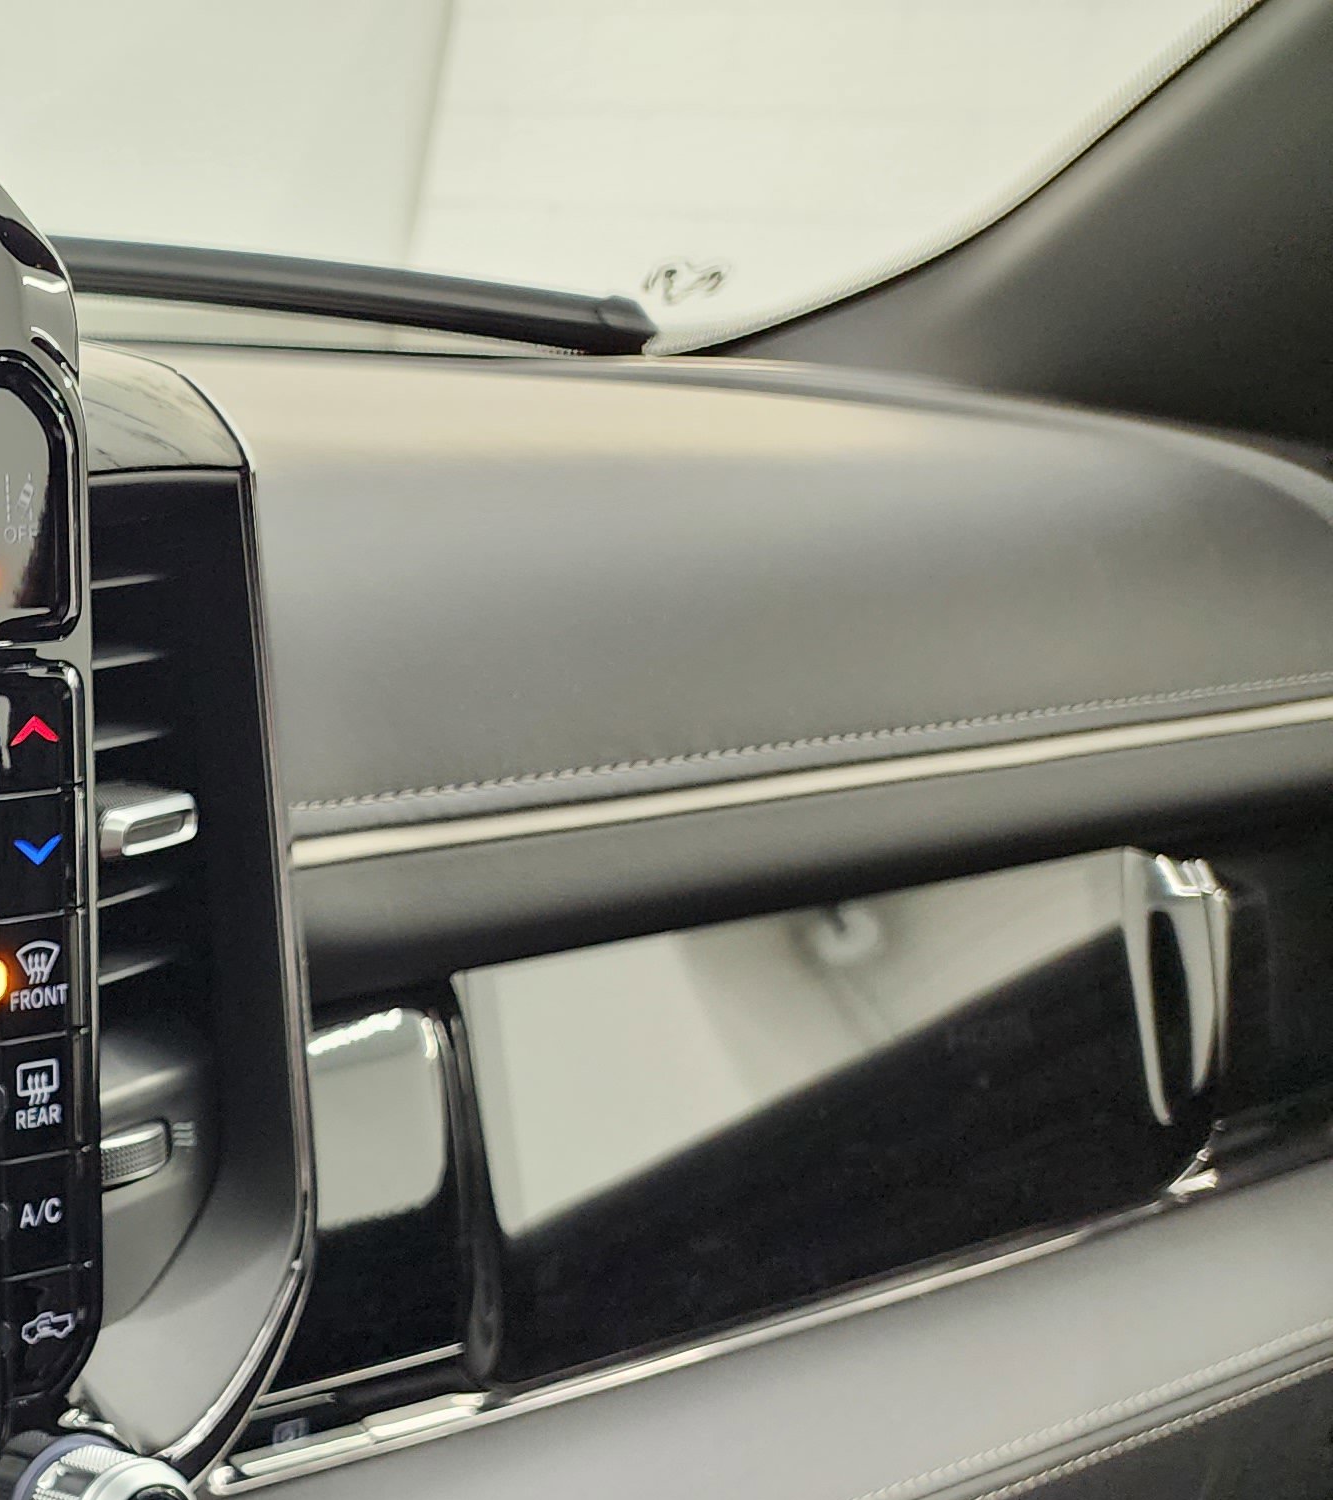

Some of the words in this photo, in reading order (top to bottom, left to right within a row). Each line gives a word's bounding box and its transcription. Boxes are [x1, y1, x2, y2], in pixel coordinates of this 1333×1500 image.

[3, 525, 39, 544] OFF
[10, 984, 68, 1012] FRONT
[15, 1105, 62, 1130] REAR
[20, 1197, 62, 1228] A/C
